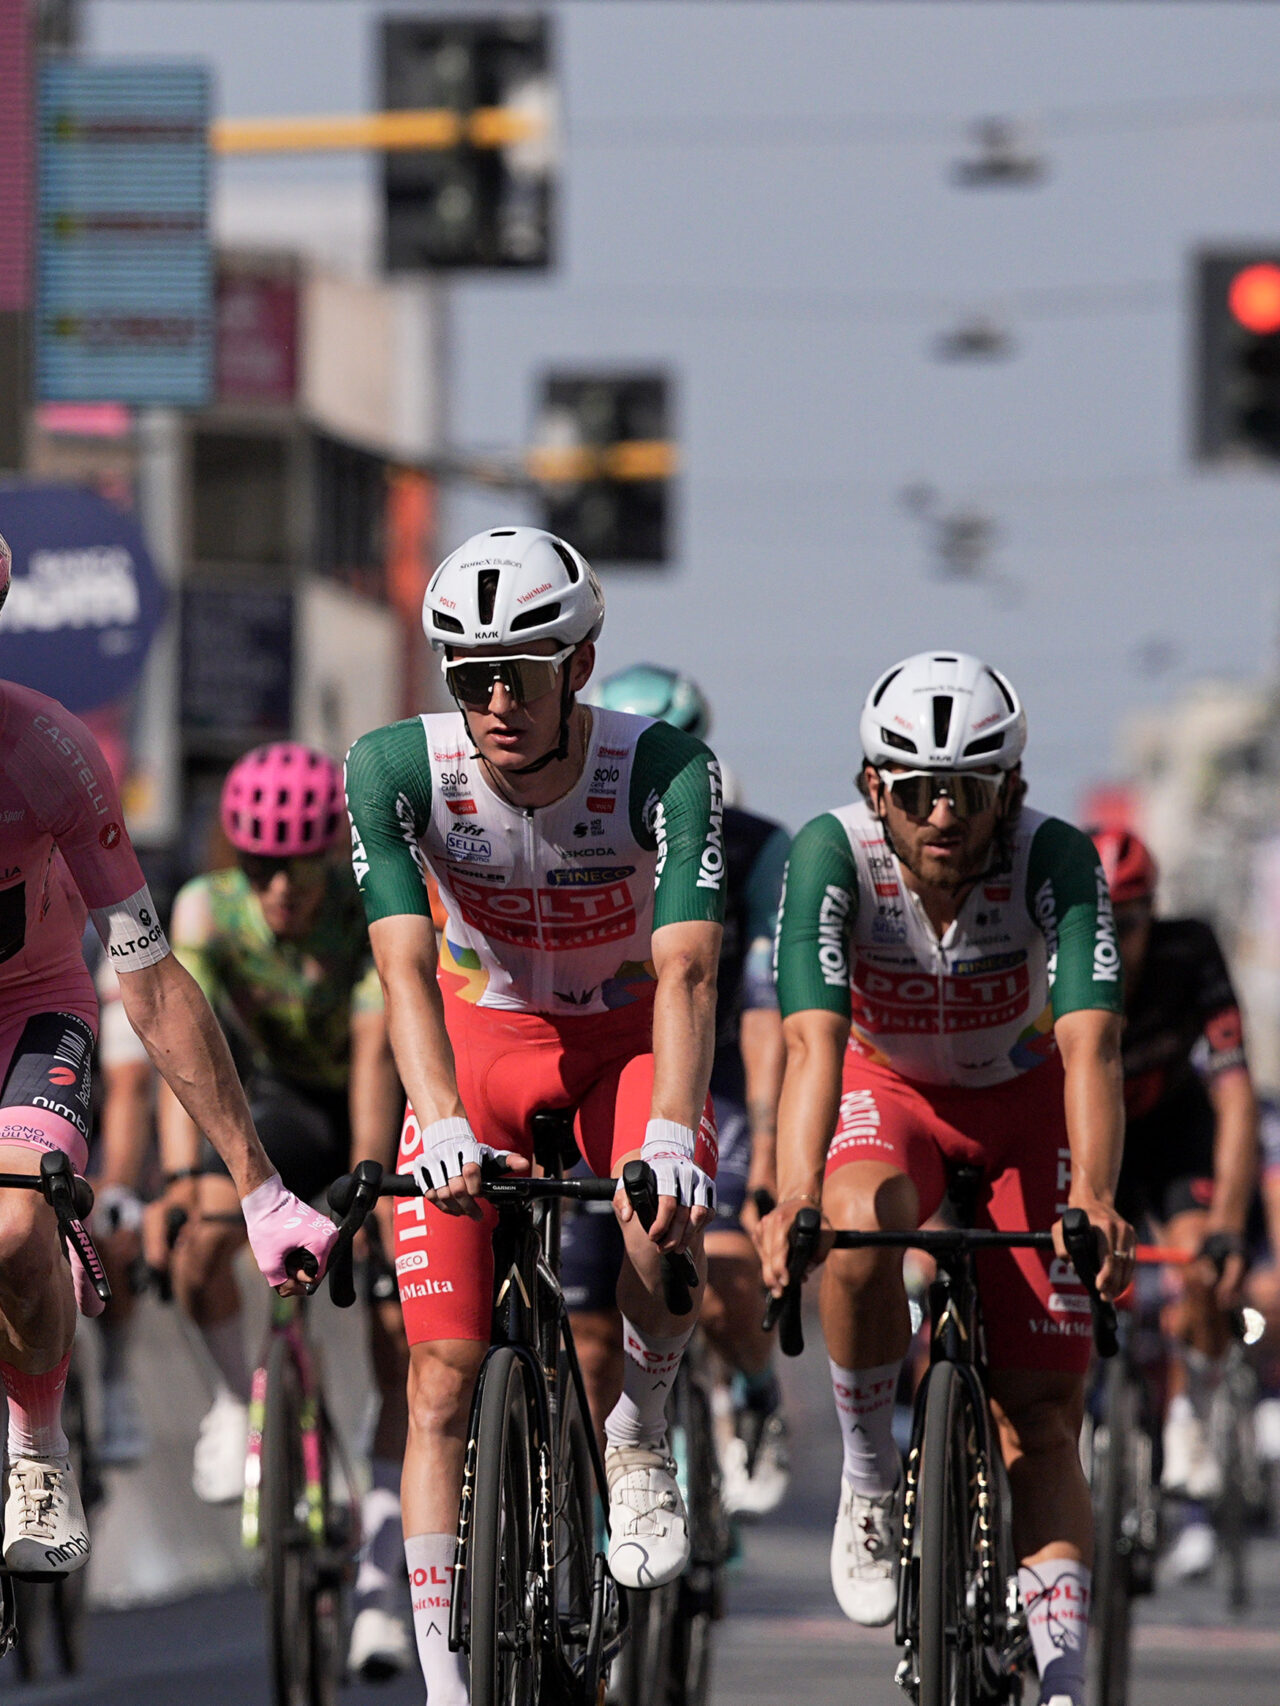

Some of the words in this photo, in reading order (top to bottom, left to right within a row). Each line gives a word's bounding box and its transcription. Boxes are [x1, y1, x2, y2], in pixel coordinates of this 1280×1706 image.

[516, 582, 553, 604] VisitMalta
[475, 631, 499, 640] KASK
[33, 715, 108, 817] CASTELLI
[441, 769, 468, 785] solo
[593, 765, 620, 782] solo
[696, 759, 725, 891] KOMETA
[448, 836, 489, 854] SELLA
[554, 868, 630, 883] FINECO
[453, 884, 631, 919] POLTI
[1093, 864, 1121, 982] KOMETA
[864, 970, 1018, 1000] POLTI
[4, 1124, 45, 1137] SONO
[32, 1095, 90, 1140] nimbl
[69, 1218, 105, 1281] SRAM
[45, 1531, 91, 1568] nimbl
